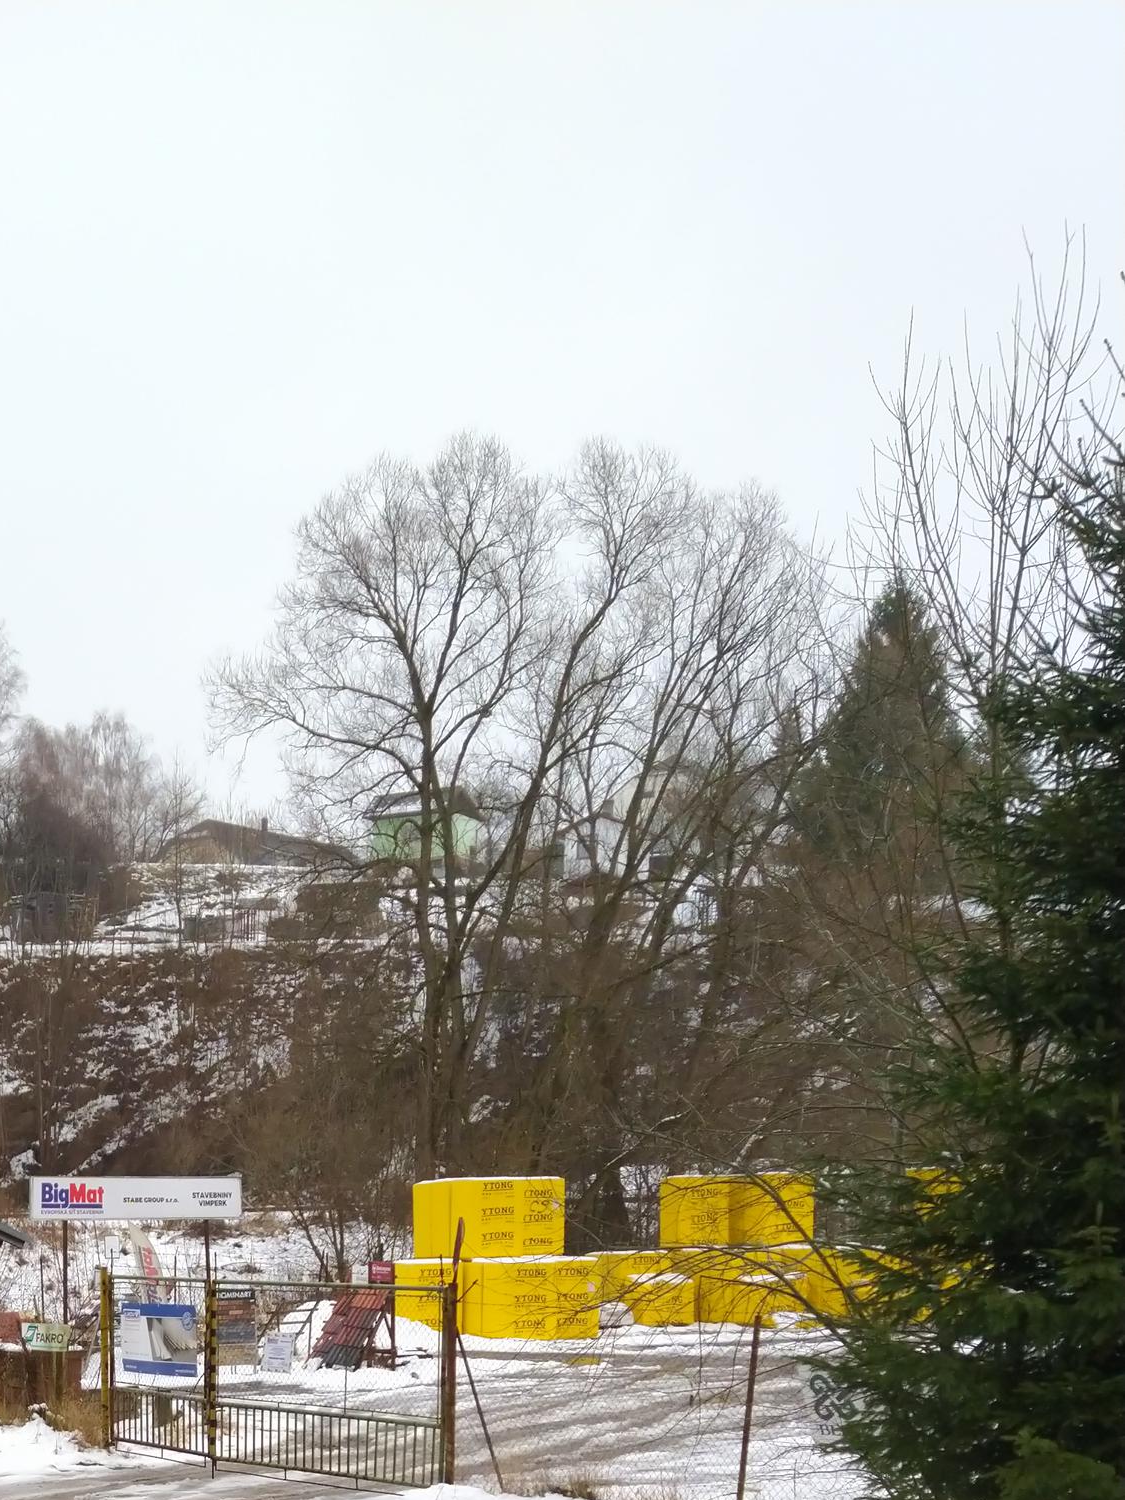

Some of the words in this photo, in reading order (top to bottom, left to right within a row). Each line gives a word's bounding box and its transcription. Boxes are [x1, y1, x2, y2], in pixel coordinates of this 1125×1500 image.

[483, 1181, 513, 1190] YTONG
[41, 1182, 104, 1209] BigMat
[192, 1191, 233, 1199] STAVEBNINY
[198, 1199, 227, 1207] VIMPERK
[481, 1206, 515, 1215] YTONG
[481, 1231, 515, 1240] YTONG
[516, 1268, 547, 1276] YTONG
[558, 1267, 589, 1276] YTONG
[515, 1294, 547, 1303] YTONG
[515, 1319, 546, 1328] YTONG
[35, 1332, 64, 1344] FAKRO
